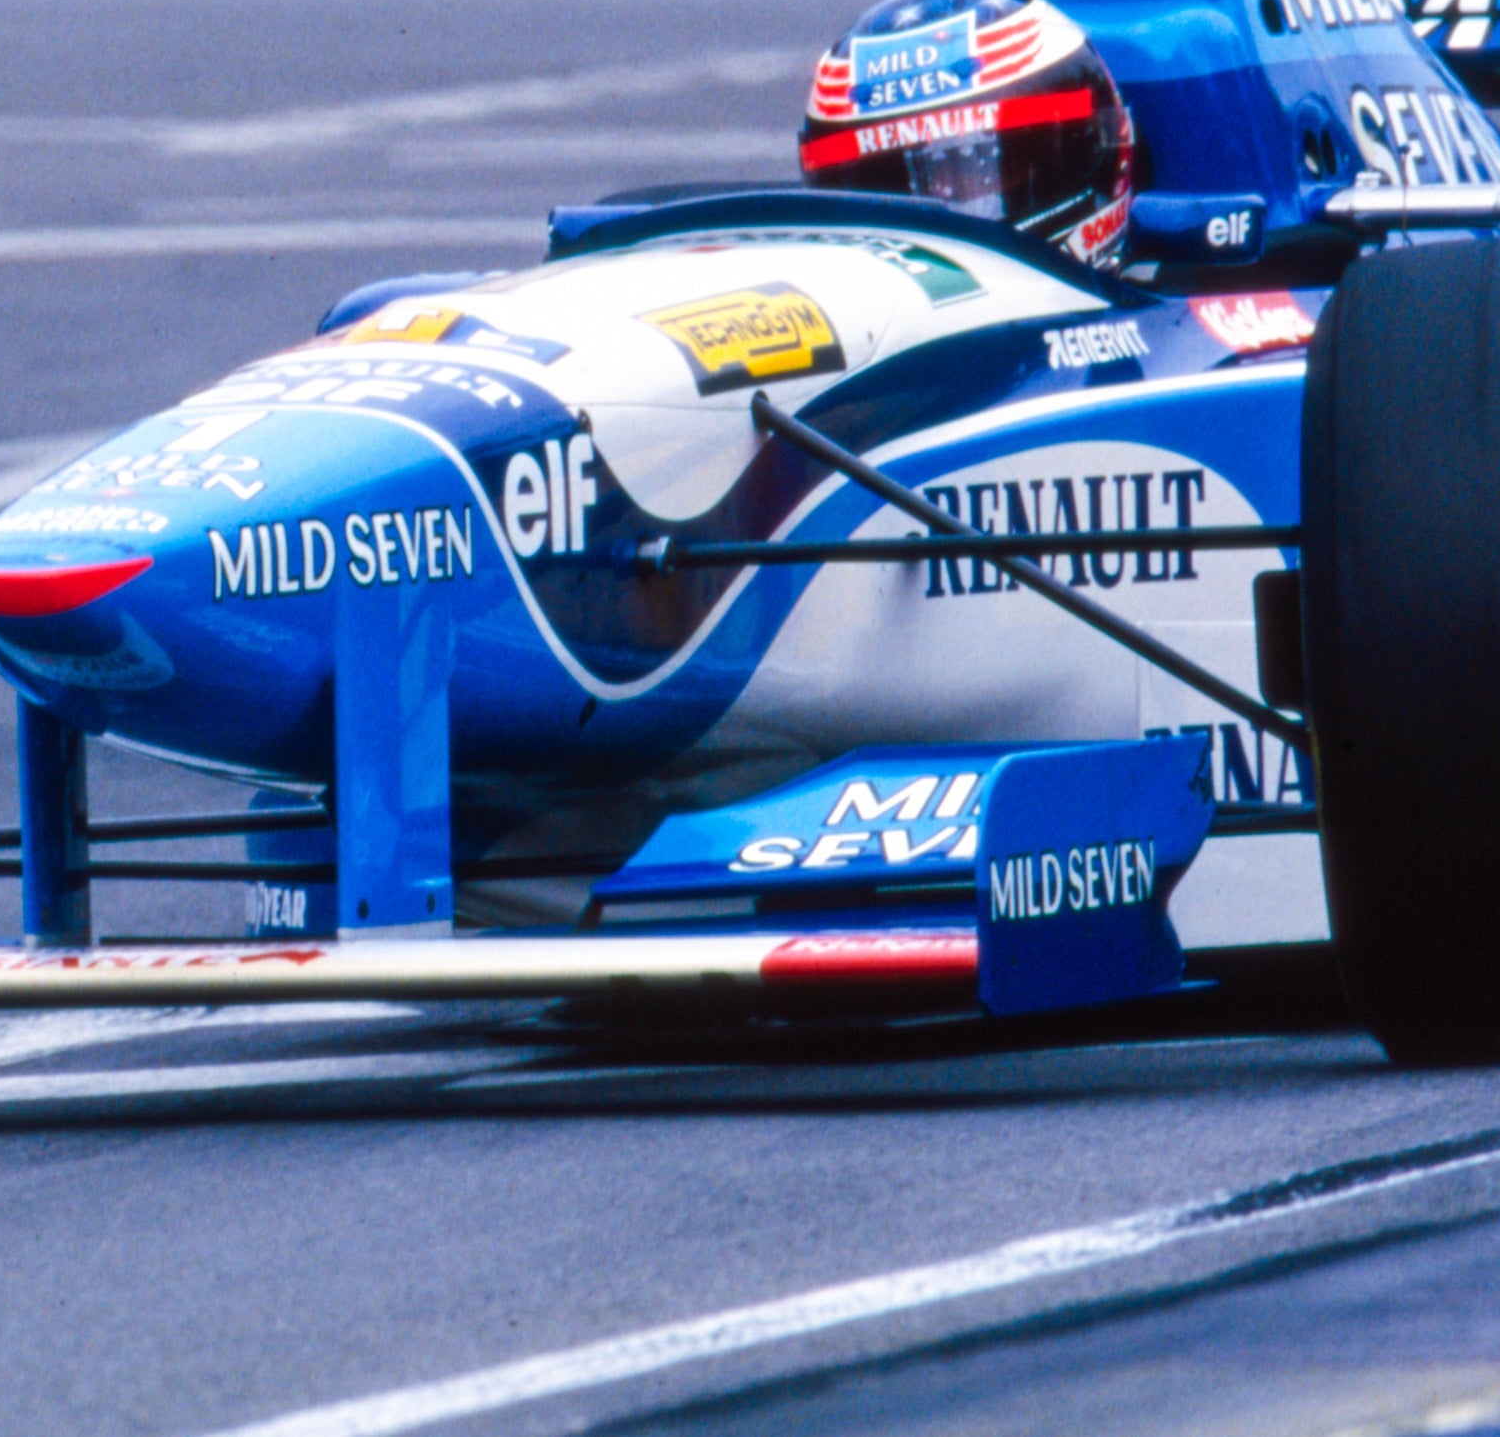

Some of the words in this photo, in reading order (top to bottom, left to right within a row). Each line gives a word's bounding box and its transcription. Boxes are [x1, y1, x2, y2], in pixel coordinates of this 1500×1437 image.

[866, 45, 938, 79] MILD
[868, 69, 960, 106] SEVEN
[855, 102, 1000, 155] RENAULT
[1207, 211, 1250, 247] elf
[503, 433, 596, 558] elf
[209, 519, 336, 600] MILD
[345, 507, 473, 586] SEVEN
[925, 470, 1205, 600] RENAULT
[990, 853, 1064, 921] MILD
[1069, 839, 1156, 911] SEVEN
